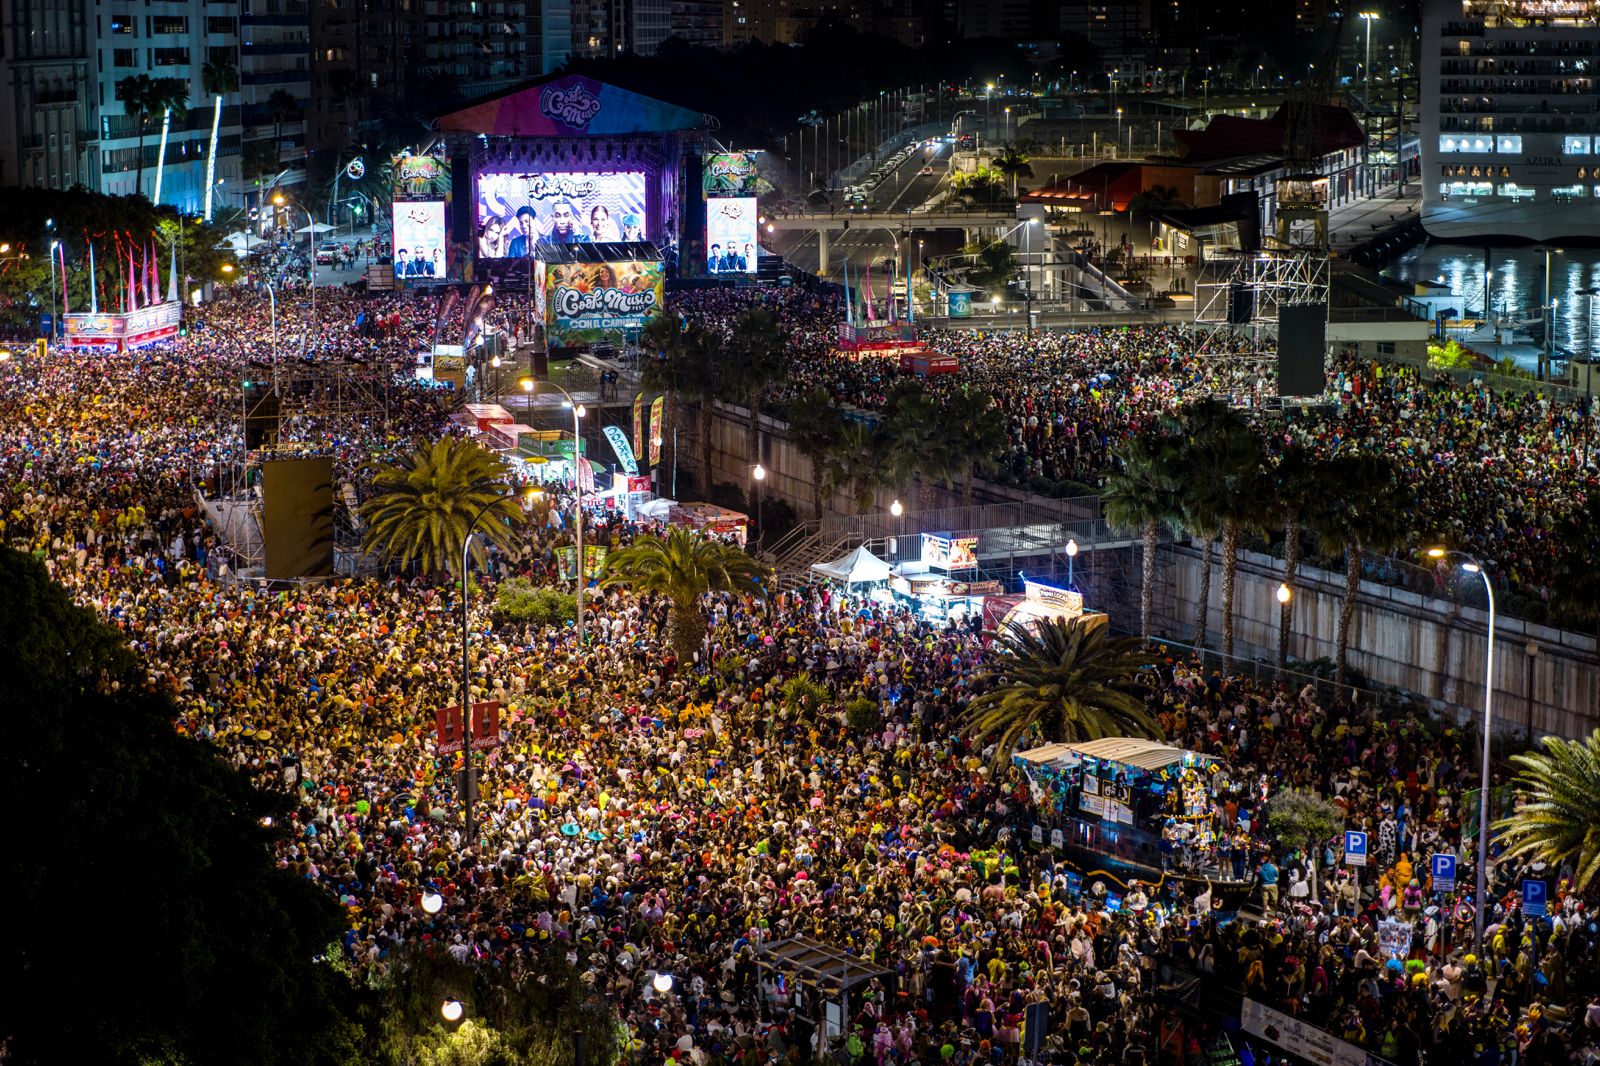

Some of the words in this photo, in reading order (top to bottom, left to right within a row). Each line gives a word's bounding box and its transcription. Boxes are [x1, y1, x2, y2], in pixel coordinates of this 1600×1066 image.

[1524, 156, 1563, 166] AZURA
[532, 178, 560, 199] Cook
[560, 179, 597, 198] Music
[561, 287, 603, 316] Cook
[604, 288, 656, 312] Music
[569, 319, 593, 329] CON
[593, 319, 601, 328] EL
[439, 741, 461, 753] Coca-Cola
[474, 736, 497, 747] Coca-Cola
[1349, 834, 1362, 851] P
[1437, 857, 1451, 875] P
[1527, 883, 1541, 900] P
